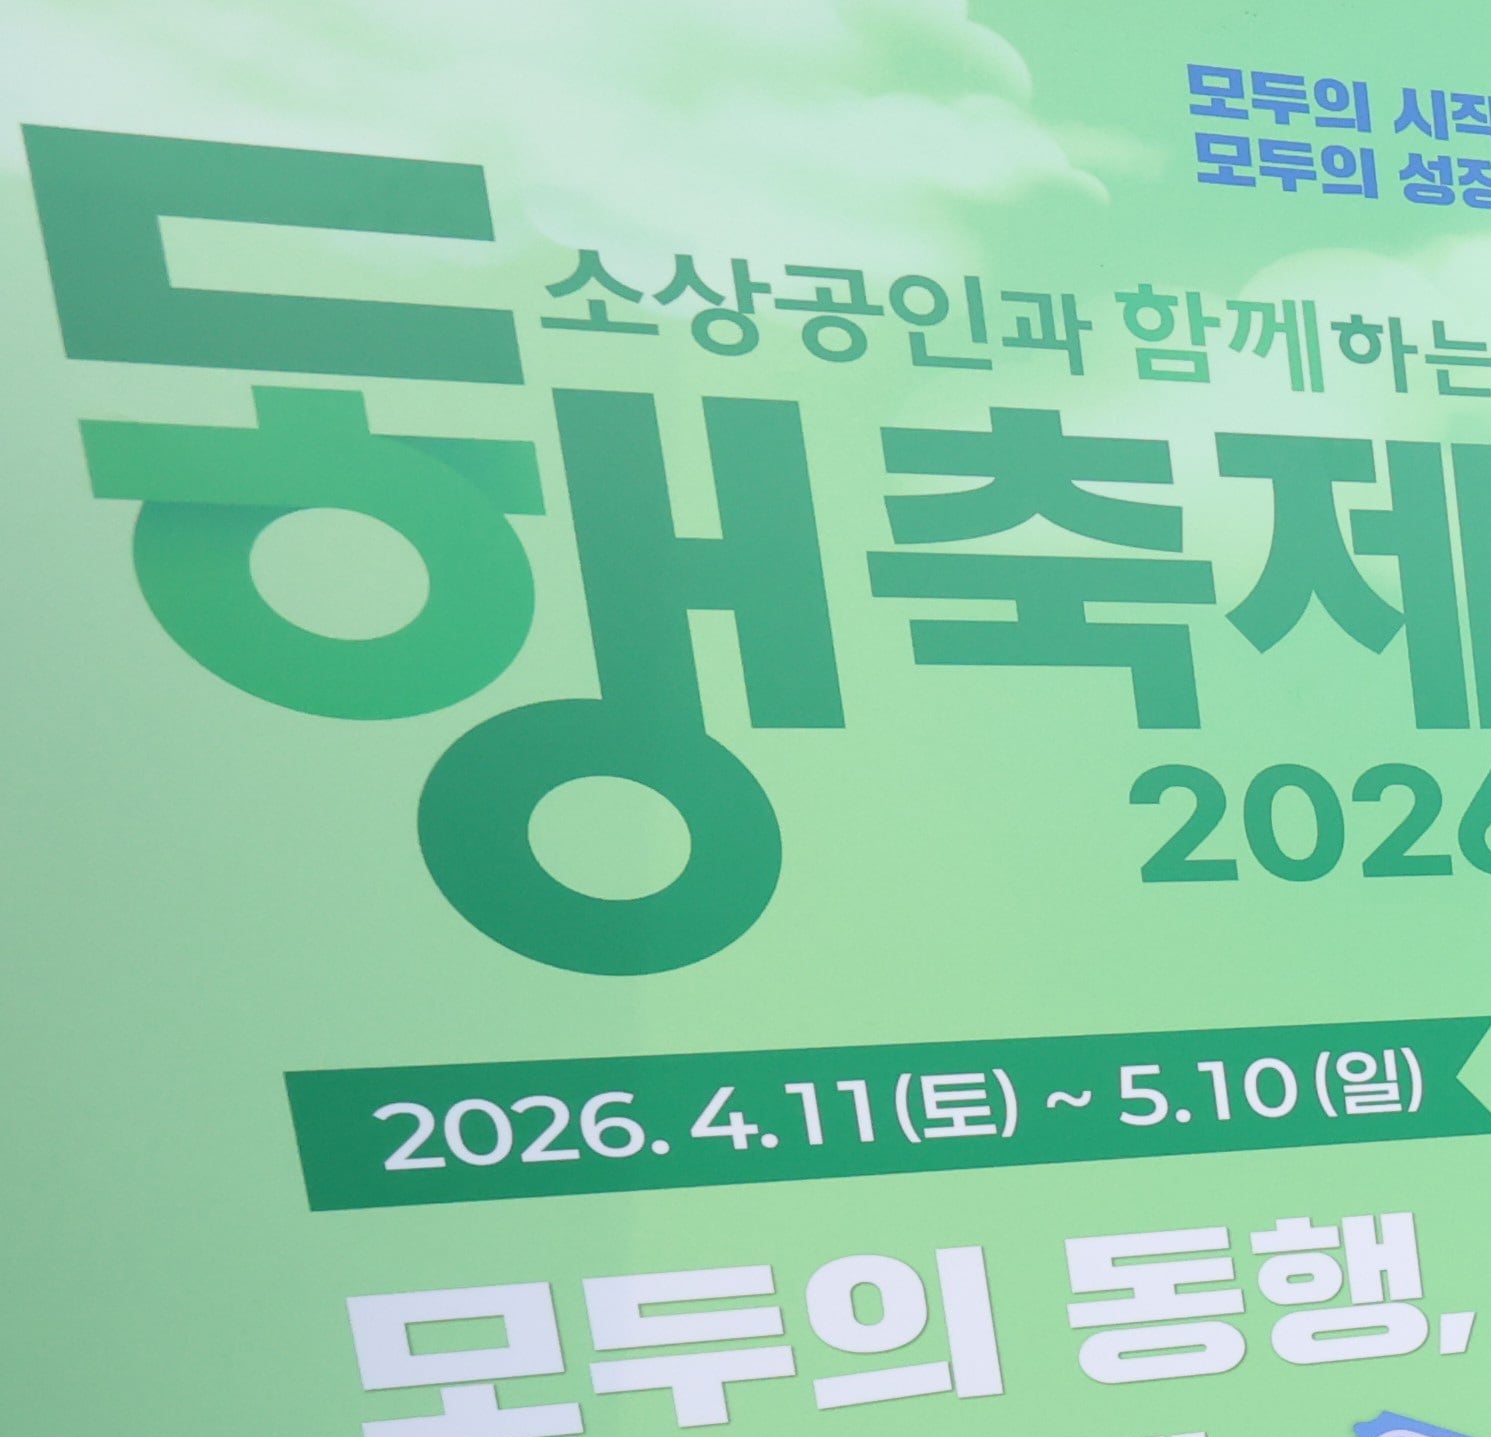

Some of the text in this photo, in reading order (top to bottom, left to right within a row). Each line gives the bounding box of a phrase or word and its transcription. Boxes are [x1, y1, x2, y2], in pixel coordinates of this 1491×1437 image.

[1187, 64, 1372, 132] 모두의
[1196, 132, 1379, 199] 모두의
[541, 250, 1092, 375] 소상공인과
[375, 1048, 1422, 1169] 2026. 4.11(토) ~ 5.10(일)
[1061, 1211, 1476, 1386] 동행,
